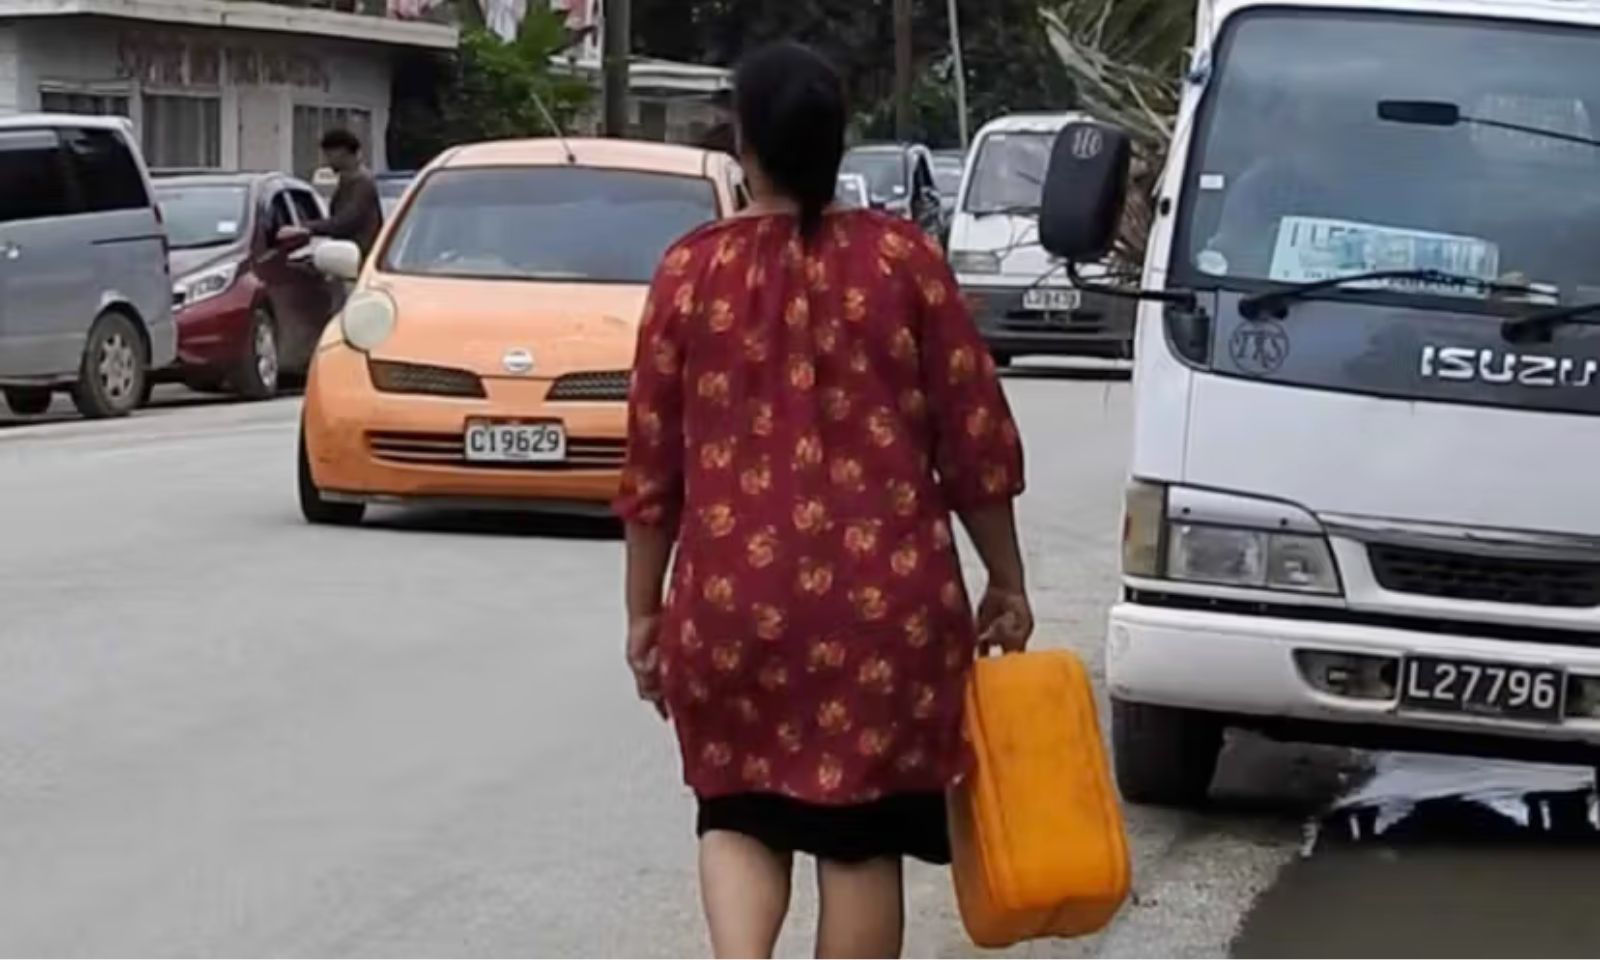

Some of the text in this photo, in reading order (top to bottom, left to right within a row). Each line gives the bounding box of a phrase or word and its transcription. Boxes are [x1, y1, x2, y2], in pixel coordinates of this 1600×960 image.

[1421, 345, 1597, 386] ISUZU
[471, 429, 559, 452] C19629
[1408, 660, 1555, 709] L27796
